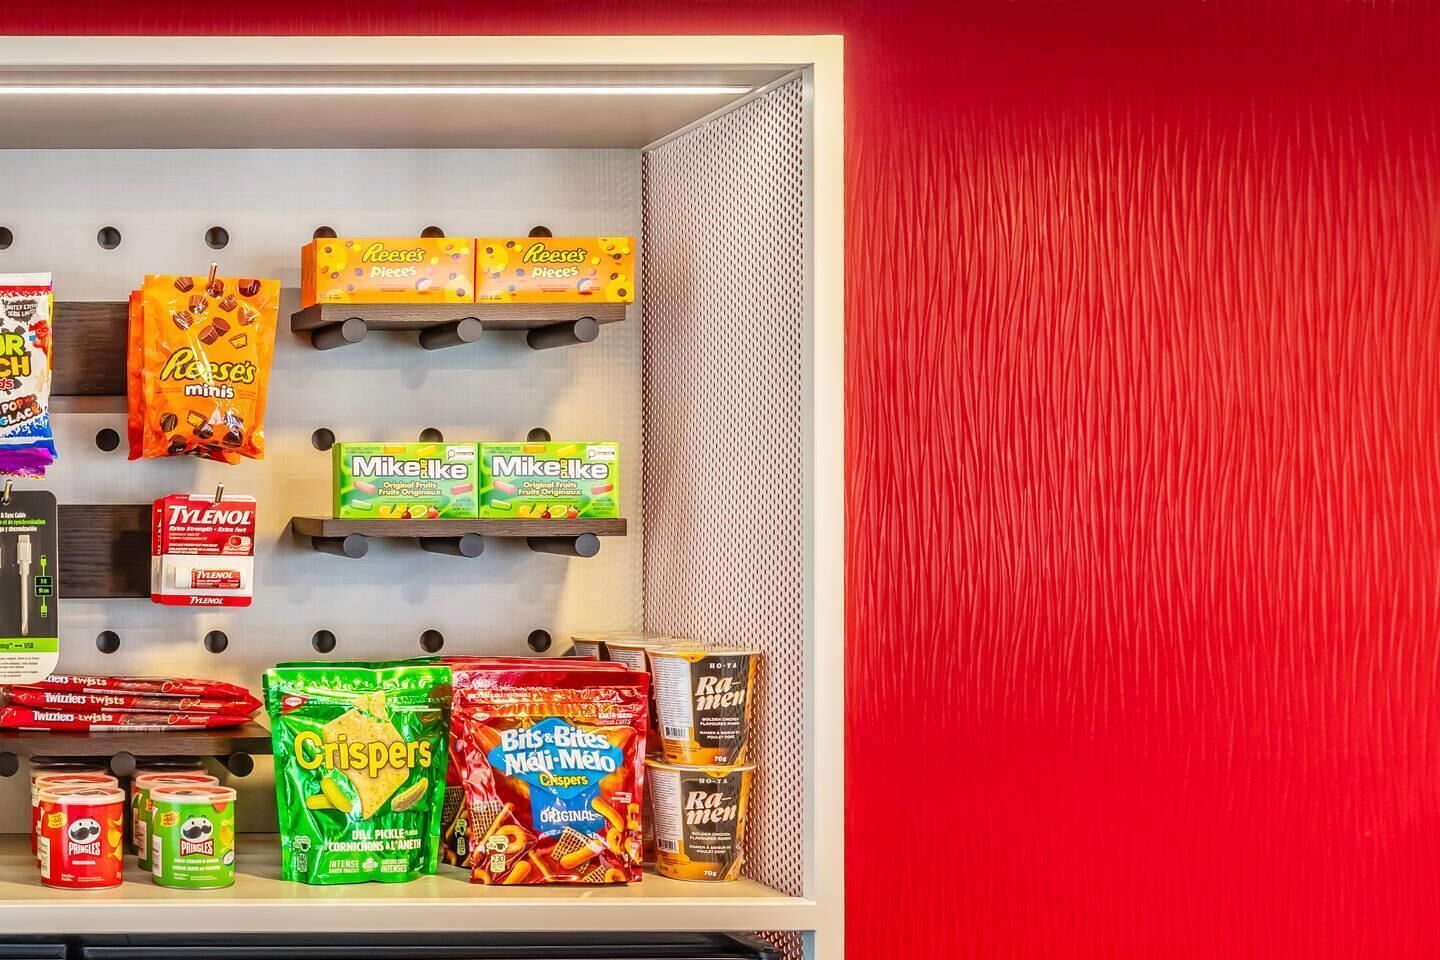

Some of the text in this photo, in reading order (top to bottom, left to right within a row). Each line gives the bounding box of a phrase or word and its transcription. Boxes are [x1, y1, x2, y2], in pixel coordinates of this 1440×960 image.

[362, 242, 425, 263] Reese's
[524, 242, 587, 263] Reese's
[161, 347, 257, 384] Reese's
[185, 383, 235, 399] minis
[1, 398, 23, 414] POP
[352, 456, 468, 480] Mike Ike
[492, 456, 609, 480] Mike Ike
[378, 488, 442, 497] Fruits Originaux
[383, 481, 438, 490] Original Fruits
[518, 488, 582, 497] Fruits Originaux
[523, 481, 577, 490] Original Fruits
[168, 505, 252, 526] TYLENOL
[196, 571, 234, 579] TYLENOL
[190, 596, 224, 605] TYLENOL
[44, 692, 125, 706] Twizzlers twists
[696, 689, 746, 711] men
[32, 710, 113, 723] Twizzlers twists
[294, 730, 432, 778] Crispers
[539, 773, 589, 788] Crispers
[686, 804, 737, 825] men
[351, 828, 405, 841] DILL PICKLE
[68, 841, 101, 857] PRINGLES
[181, 840, 213, 856] PRINGLES
[329, 840, 385, 852] CORNICHONS
